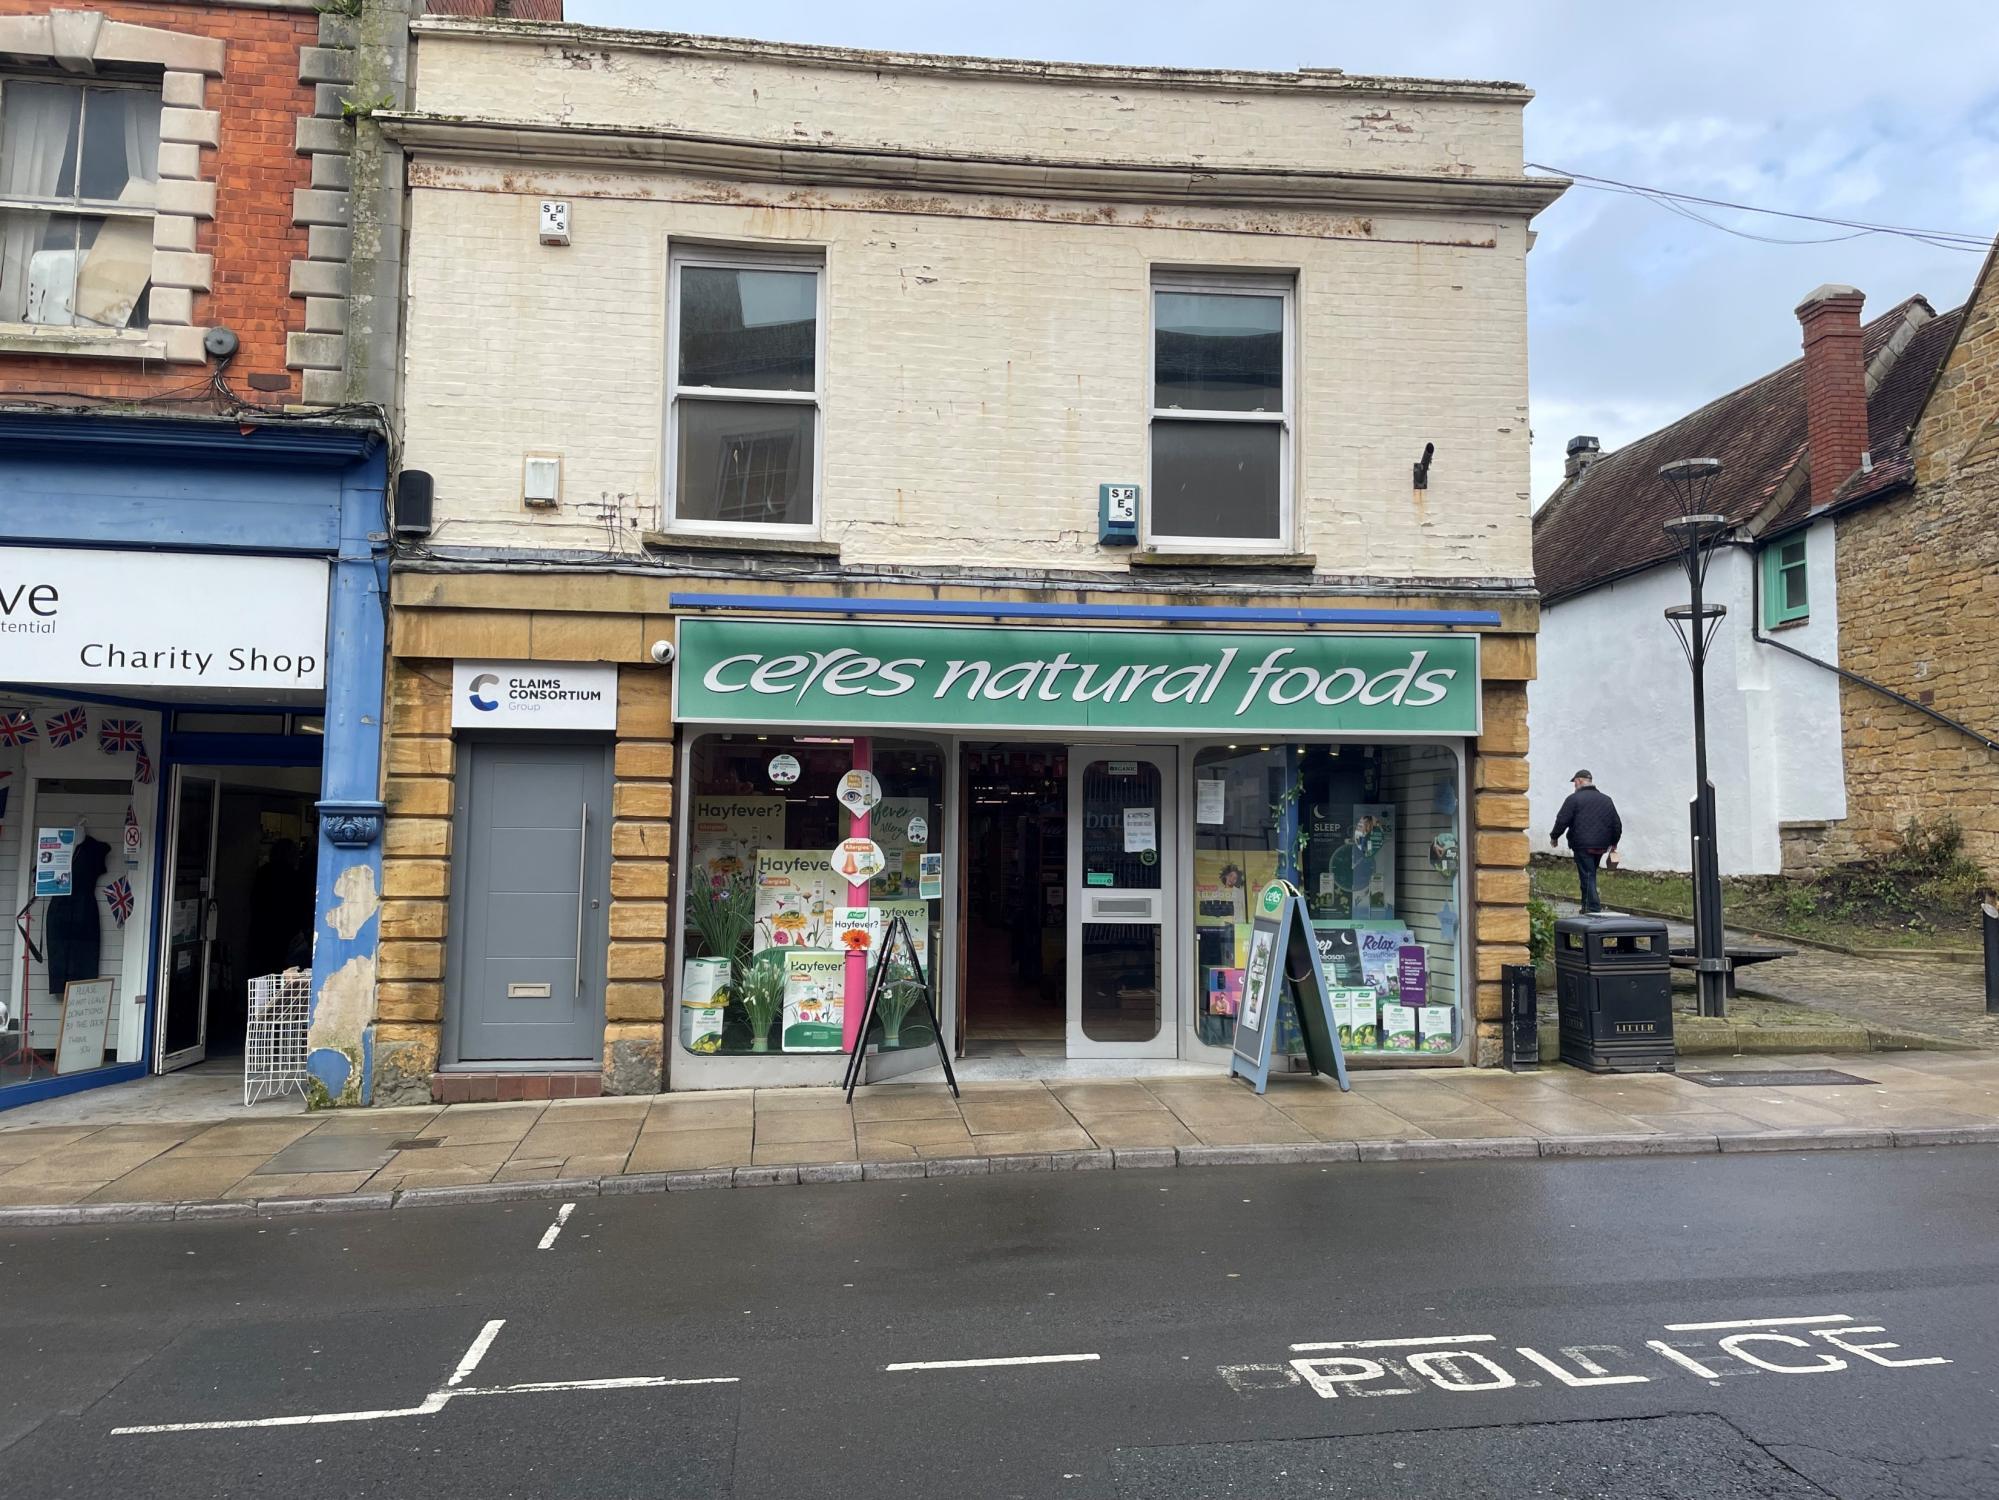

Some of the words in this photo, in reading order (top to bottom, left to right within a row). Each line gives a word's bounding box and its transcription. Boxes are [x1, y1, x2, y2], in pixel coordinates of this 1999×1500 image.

[1, 620, 56, 633] tential
[80, 643, 213, 675] Charity
[228, 648, 316, 678] Shop
[509, 678, 561, 689] CLAIMS
[933, 648, 1239, 704] natural
[1234, 648, 1457, 716] foods
[509, 690, 601, 701] CONSORTIUM
[508, 702, 541, 712] Group
[698, 803, 783, 820] Hayfever?
[1313, 823, 1341, 832] SLEEP
[760, 857, 835, 874] Hayfeve
[880, 907, 926, 918] ayfever?
[834, 920, 879, 930] Hayfever?
[1362, 935, 1395, 951] Relax
[1616, 1024, 1654, 1032] LITTER
[1289, 1325, 1955, 1399] POLICE
